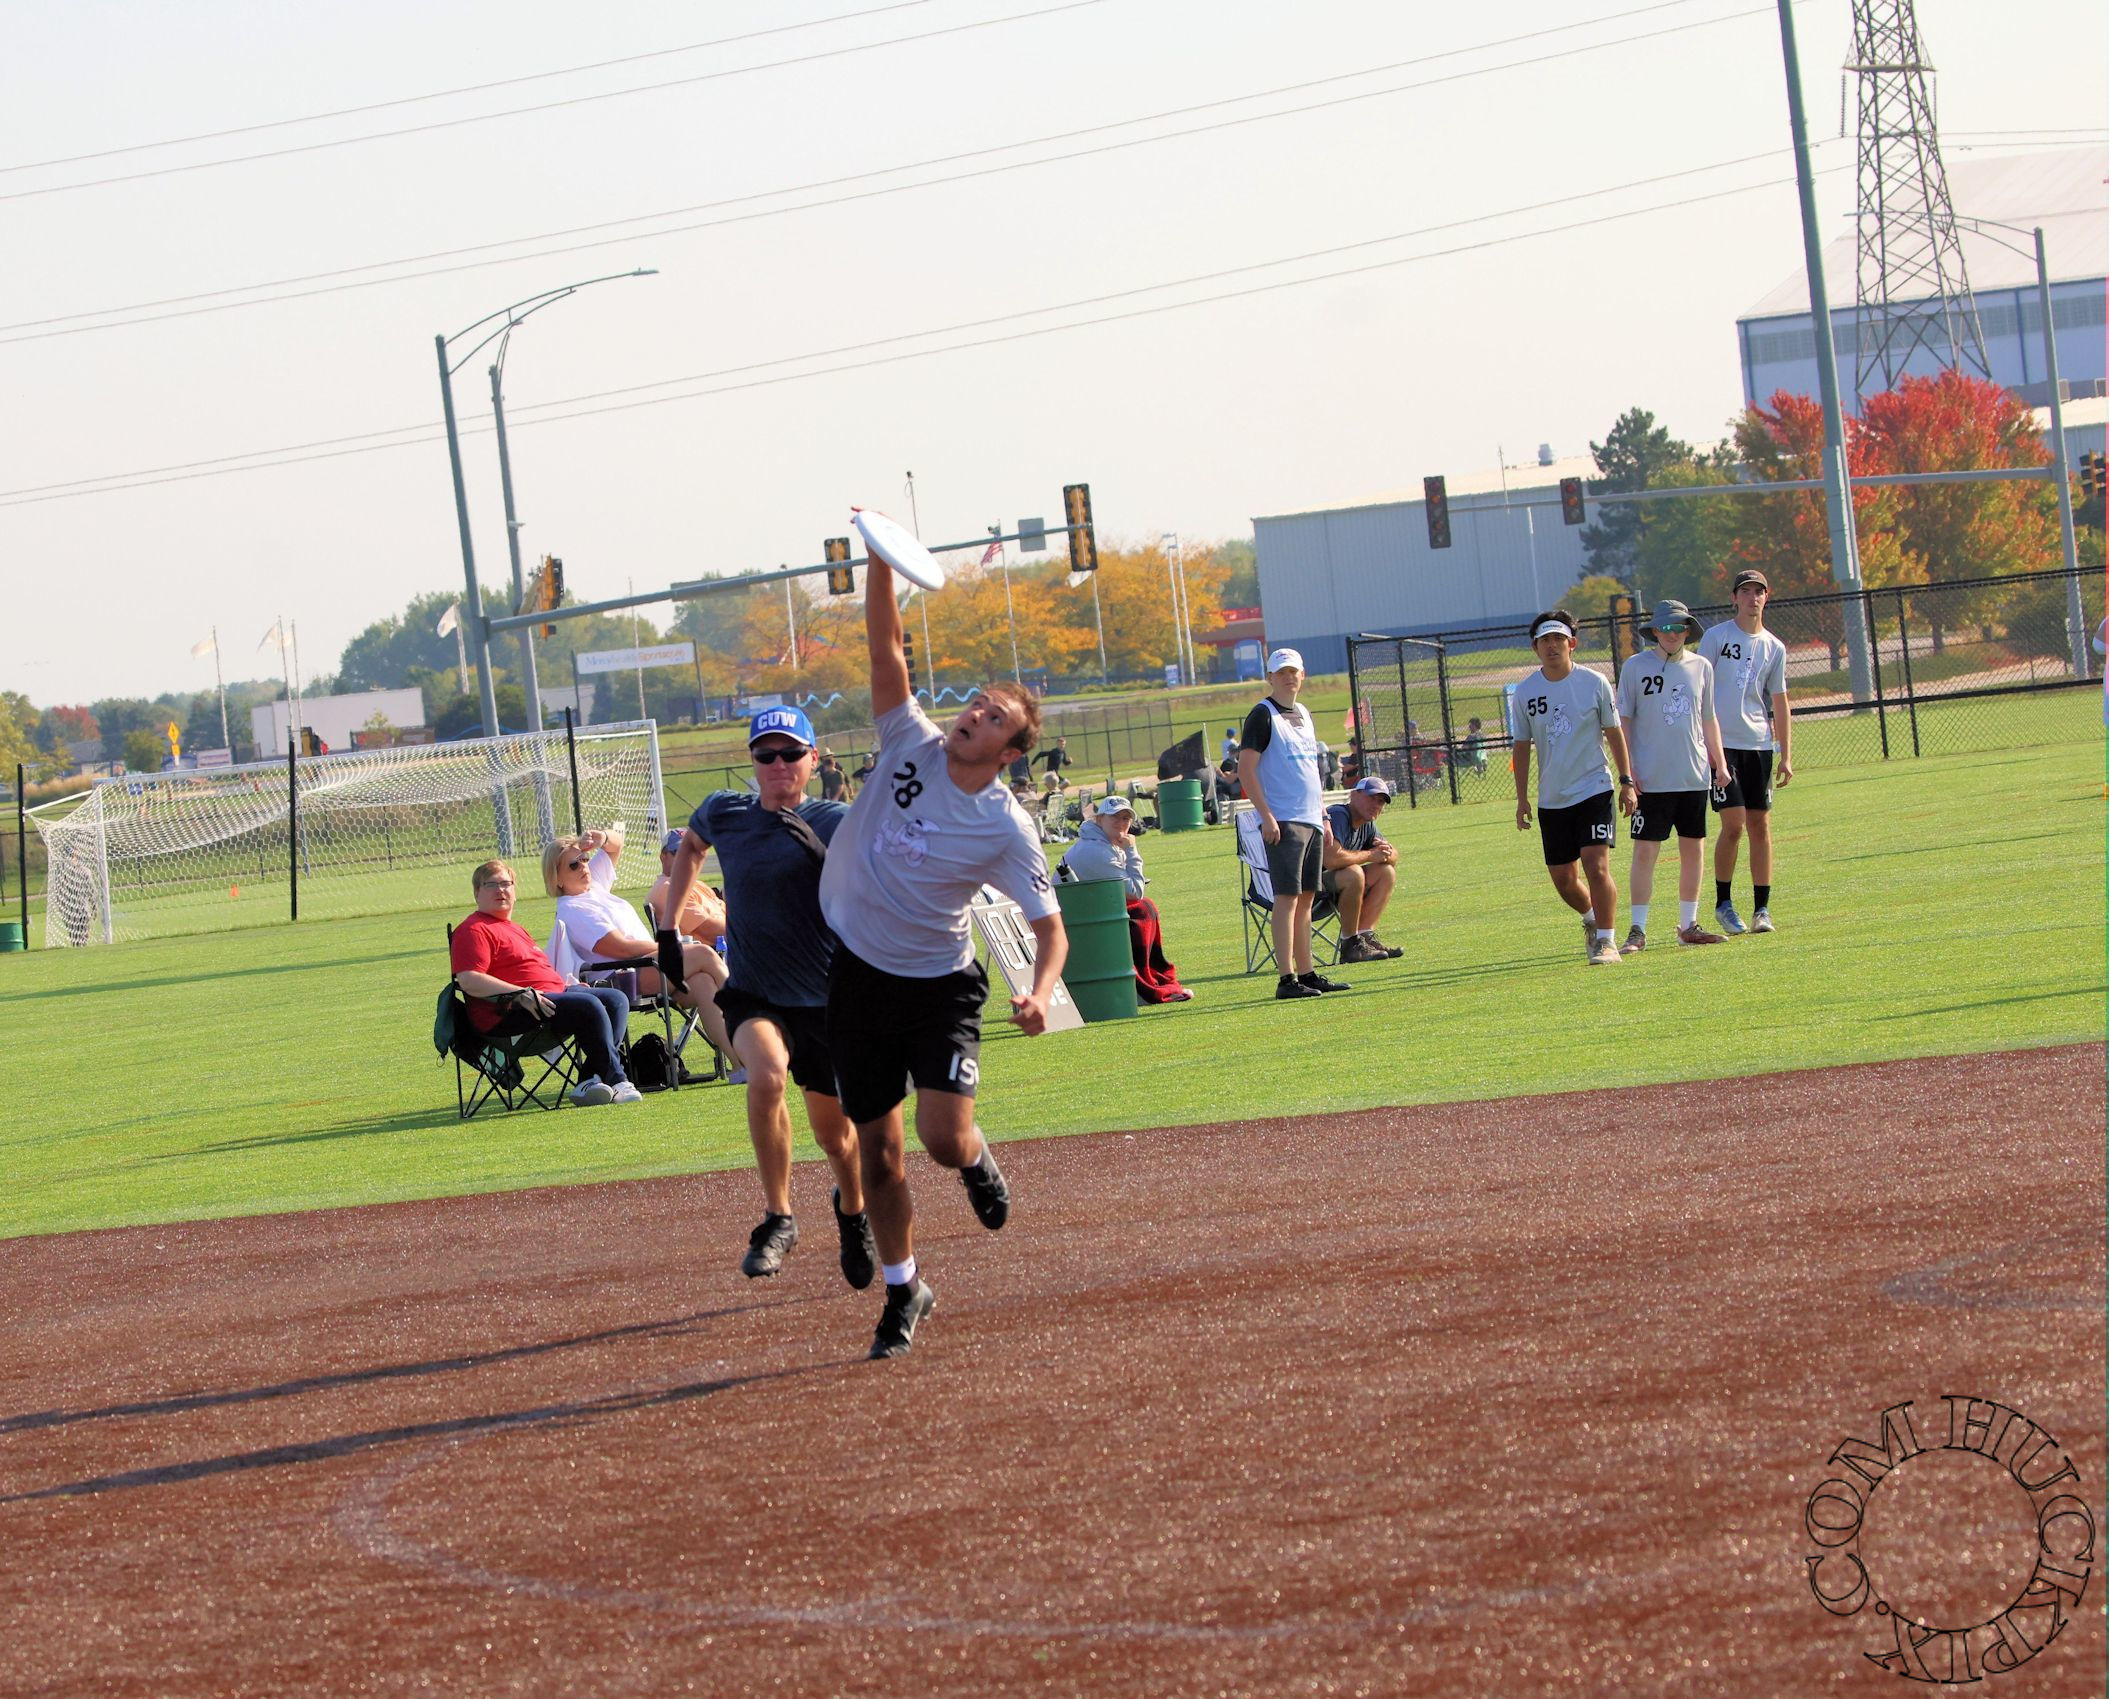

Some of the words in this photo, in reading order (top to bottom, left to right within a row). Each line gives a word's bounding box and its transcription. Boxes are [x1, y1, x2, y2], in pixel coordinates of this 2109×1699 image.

[1720, 643, 1741, 660] 43
[1641, 675, 1664, 696] 29
[1527, 696, 1548, 716] 55
[893, 761, 923, 809] 28
[1591, 824, 1614, 840] ISU
[1631, 815, 1645, 835] 29
